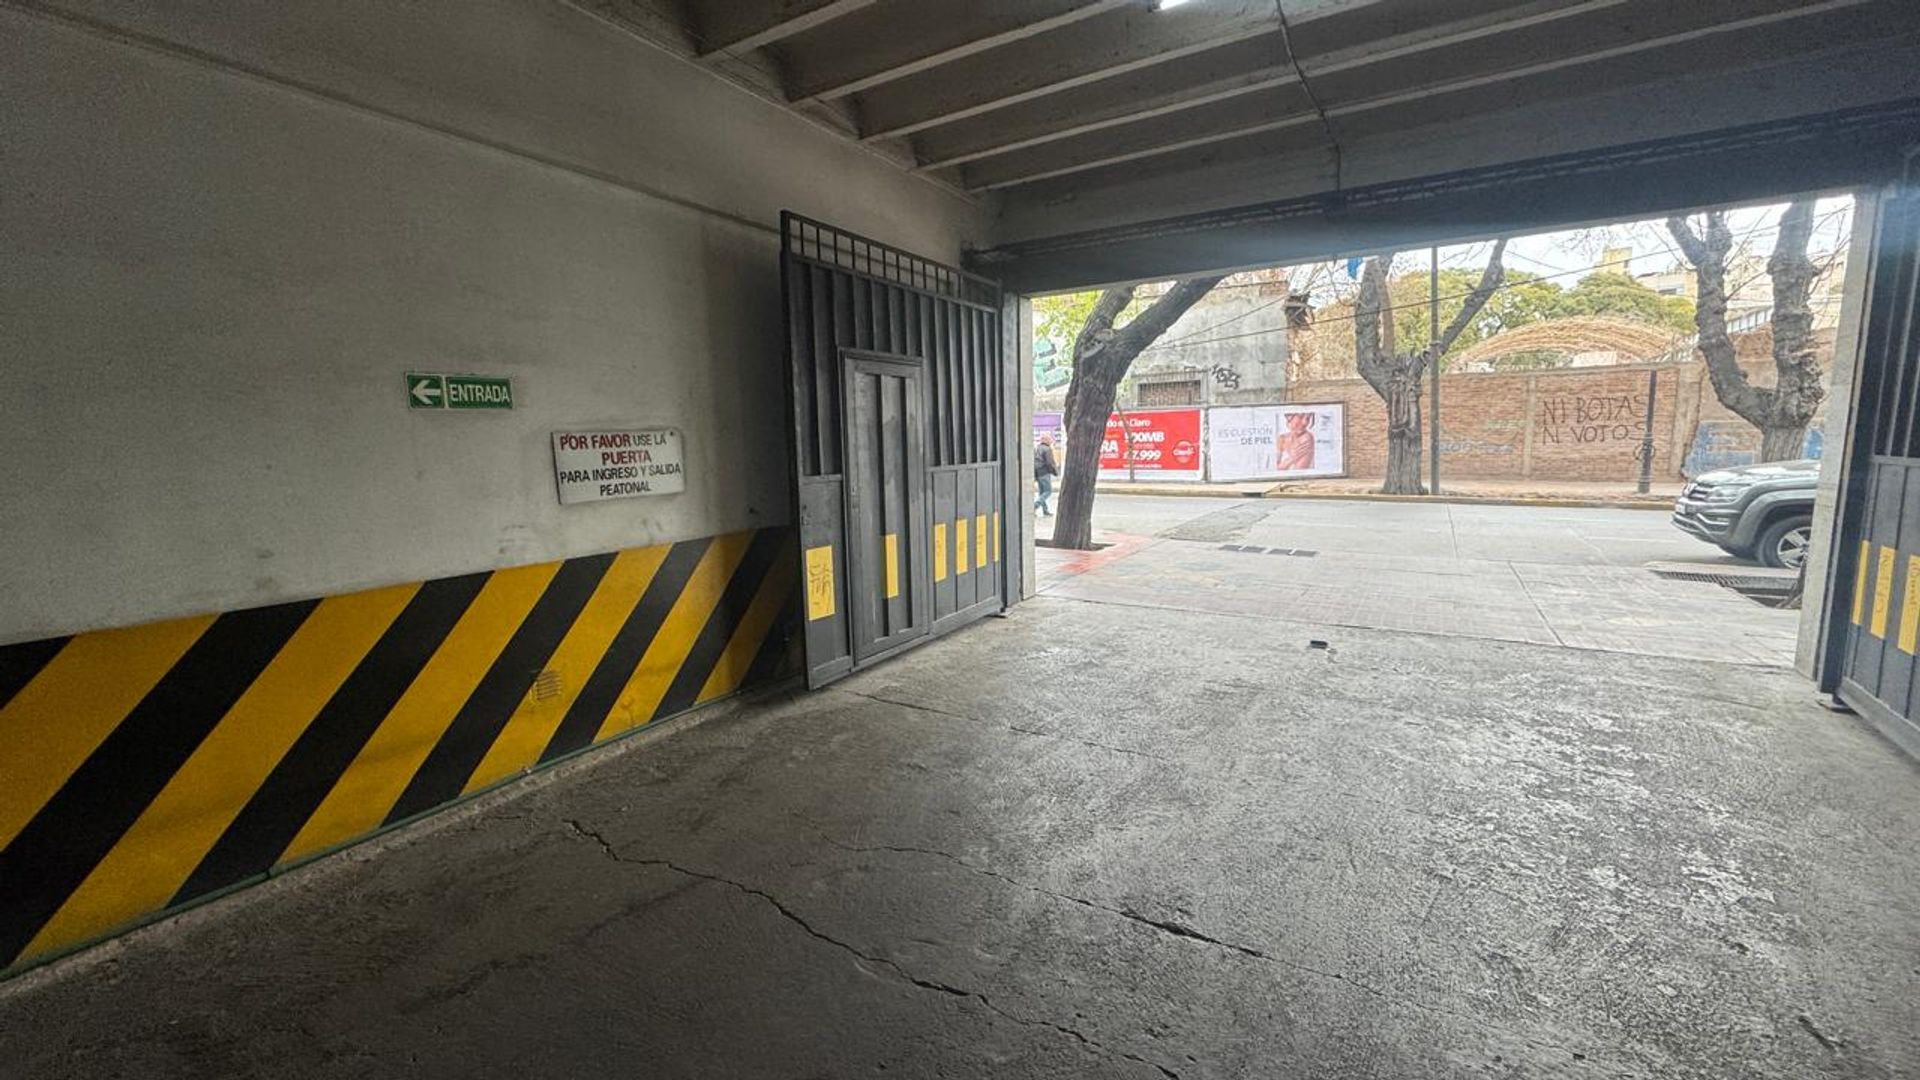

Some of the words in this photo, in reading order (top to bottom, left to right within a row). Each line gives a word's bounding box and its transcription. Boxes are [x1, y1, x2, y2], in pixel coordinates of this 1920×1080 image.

[449, 384, 510, 403] ENTRADA
[1542, 397, 1566, 424] NI
[1576, 394, 1647, 424] BOTAS
[1129, 418, 1151, 427] Claro
[1570, 420, 1646, 443] VOTOS
[560, 433, 588, 450] POR
[591, 433, 631, 449] FAVOR
[633, 433, 652, 446] USE
[654, 433, 667, 445] LA
[1241, 437, 1253, 445] DE
[1255, 436, 1273, 445] PIEL
[602, 450, 652, 466] PUERTA
[560, 467, 591, 484] PARA
[592, 464, 638, 482] INGRESO
[639, 464, 647, 477] Y
[649, 462, 681, 476] SALIDA
[600, 481, 652, 496] PEATONAL
